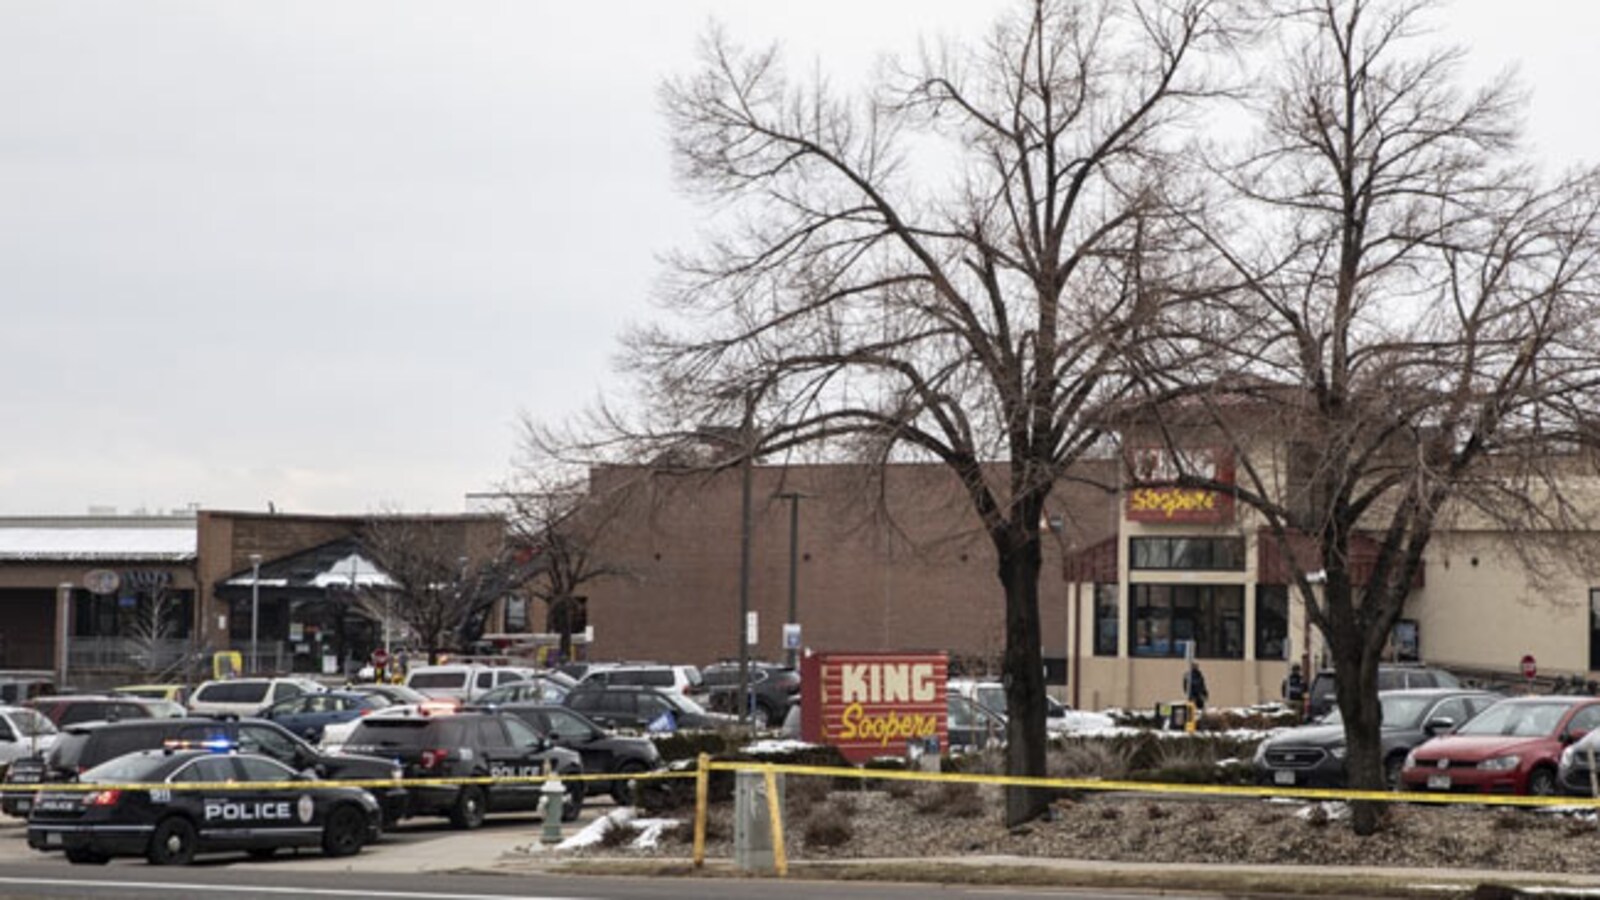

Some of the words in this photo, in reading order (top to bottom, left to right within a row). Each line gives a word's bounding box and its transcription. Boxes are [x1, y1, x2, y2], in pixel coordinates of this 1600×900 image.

[841, 663, 935, 702] KING
[839, 703, 937, 746] Soopers
[491, 766, 540, 778] POLICE
[204, 803, 291, 820] POLICE
